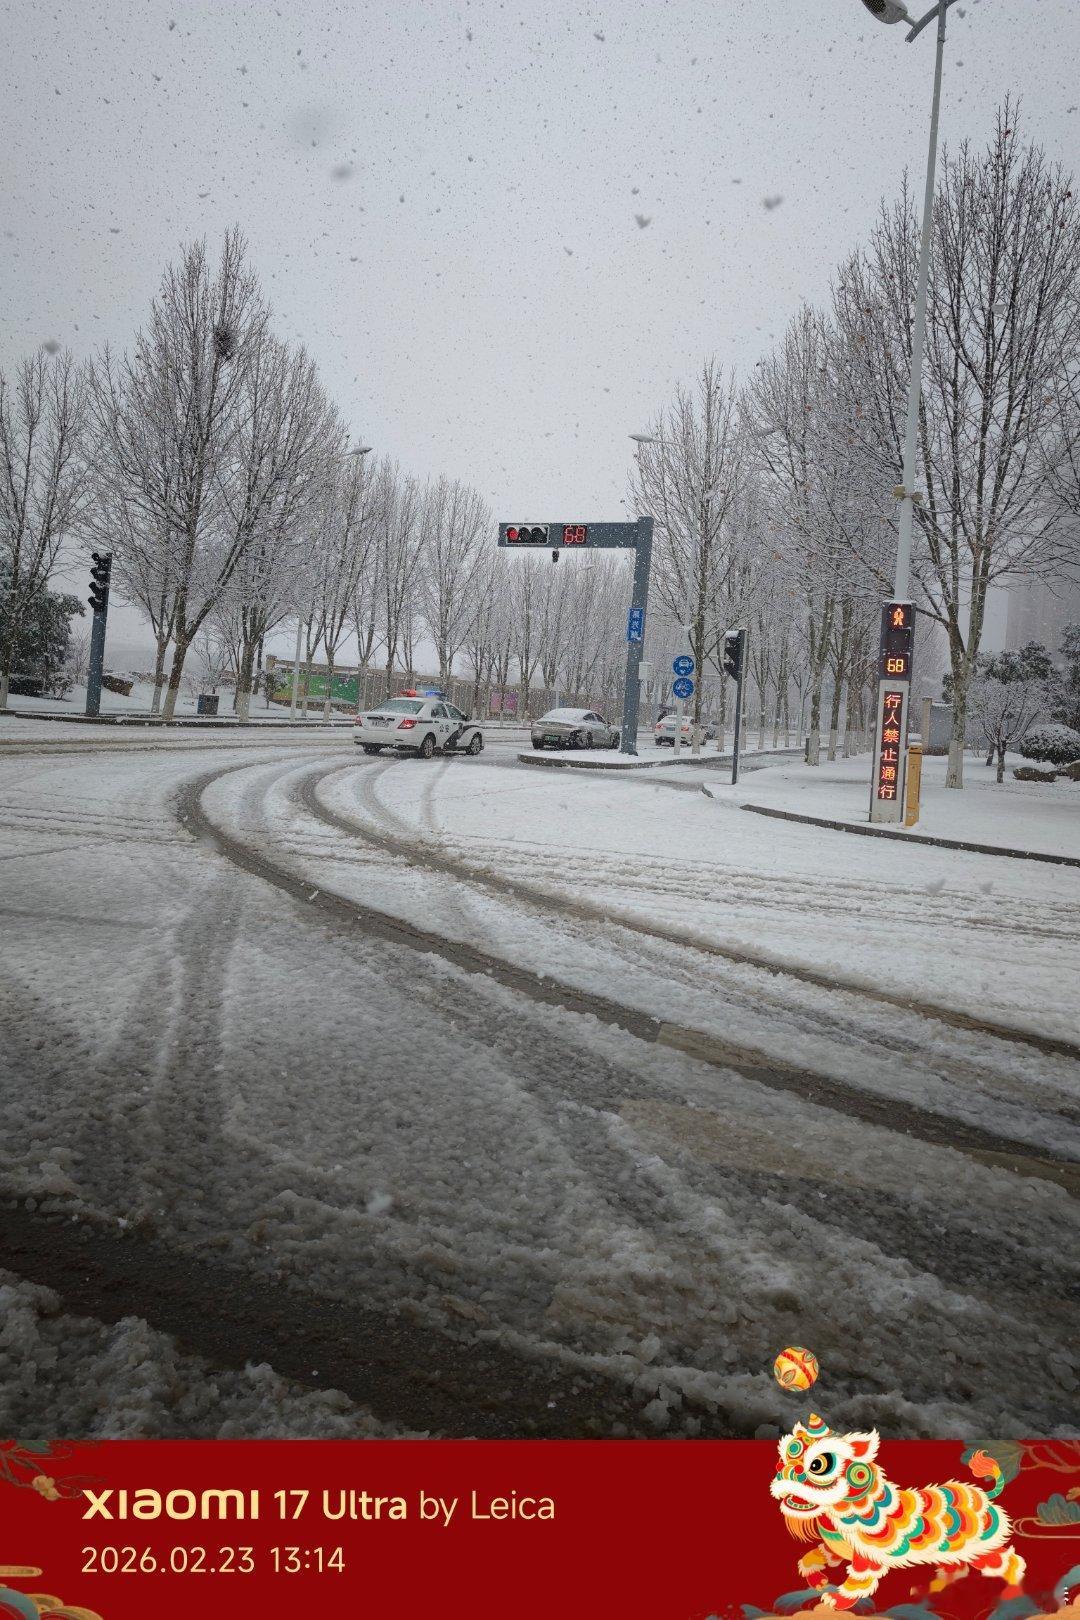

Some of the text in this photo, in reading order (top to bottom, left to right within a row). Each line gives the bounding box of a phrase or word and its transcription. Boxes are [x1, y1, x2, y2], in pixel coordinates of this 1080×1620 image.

[887, 658, 904, 673] 68
[880, 694, 902, 799] 行人禁止通行
